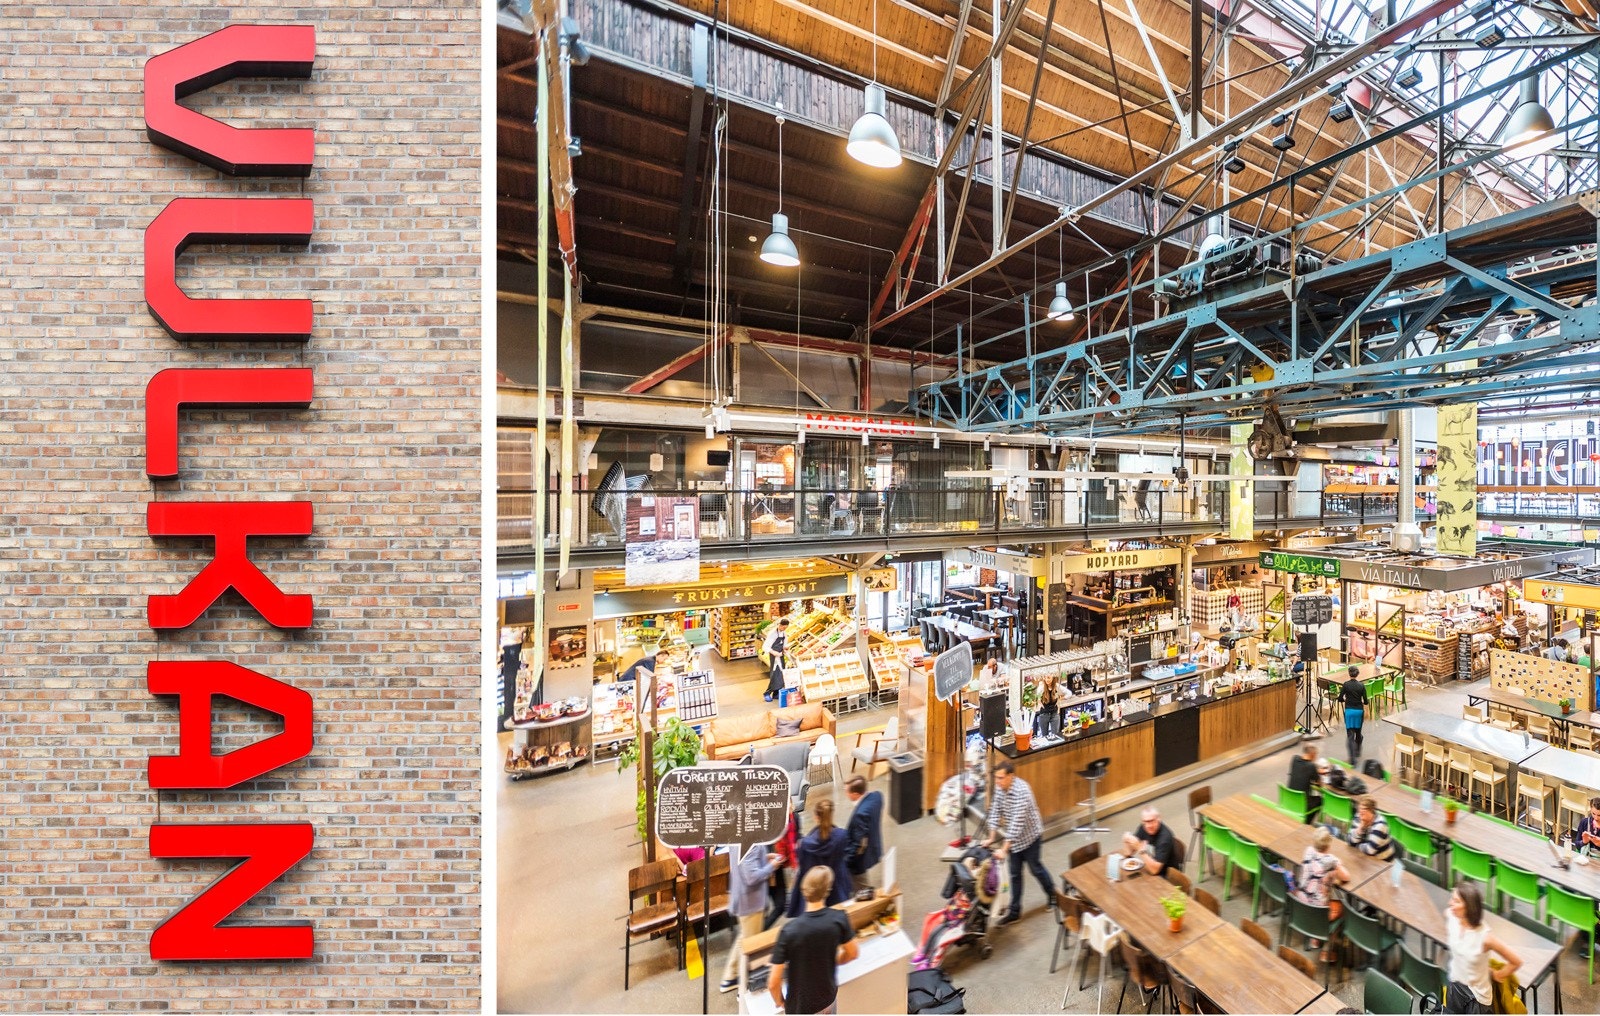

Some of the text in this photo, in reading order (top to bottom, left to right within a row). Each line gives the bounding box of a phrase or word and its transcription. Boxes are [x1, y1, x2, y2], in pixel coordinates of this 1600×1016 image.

[145, 25, 316, 962] VULKAN
[1087, 554, 1138, 569] HOPYARD
[1361, 567, 1421, 588] VIA ITALIA
[1492, 564, 1523, 581] VIA ITALIA
[674, 590, 731, 603] FRUKT
[744, 586, 754, 597] &
[672, 769, 782, 783] TORGET BAR TILBYR
